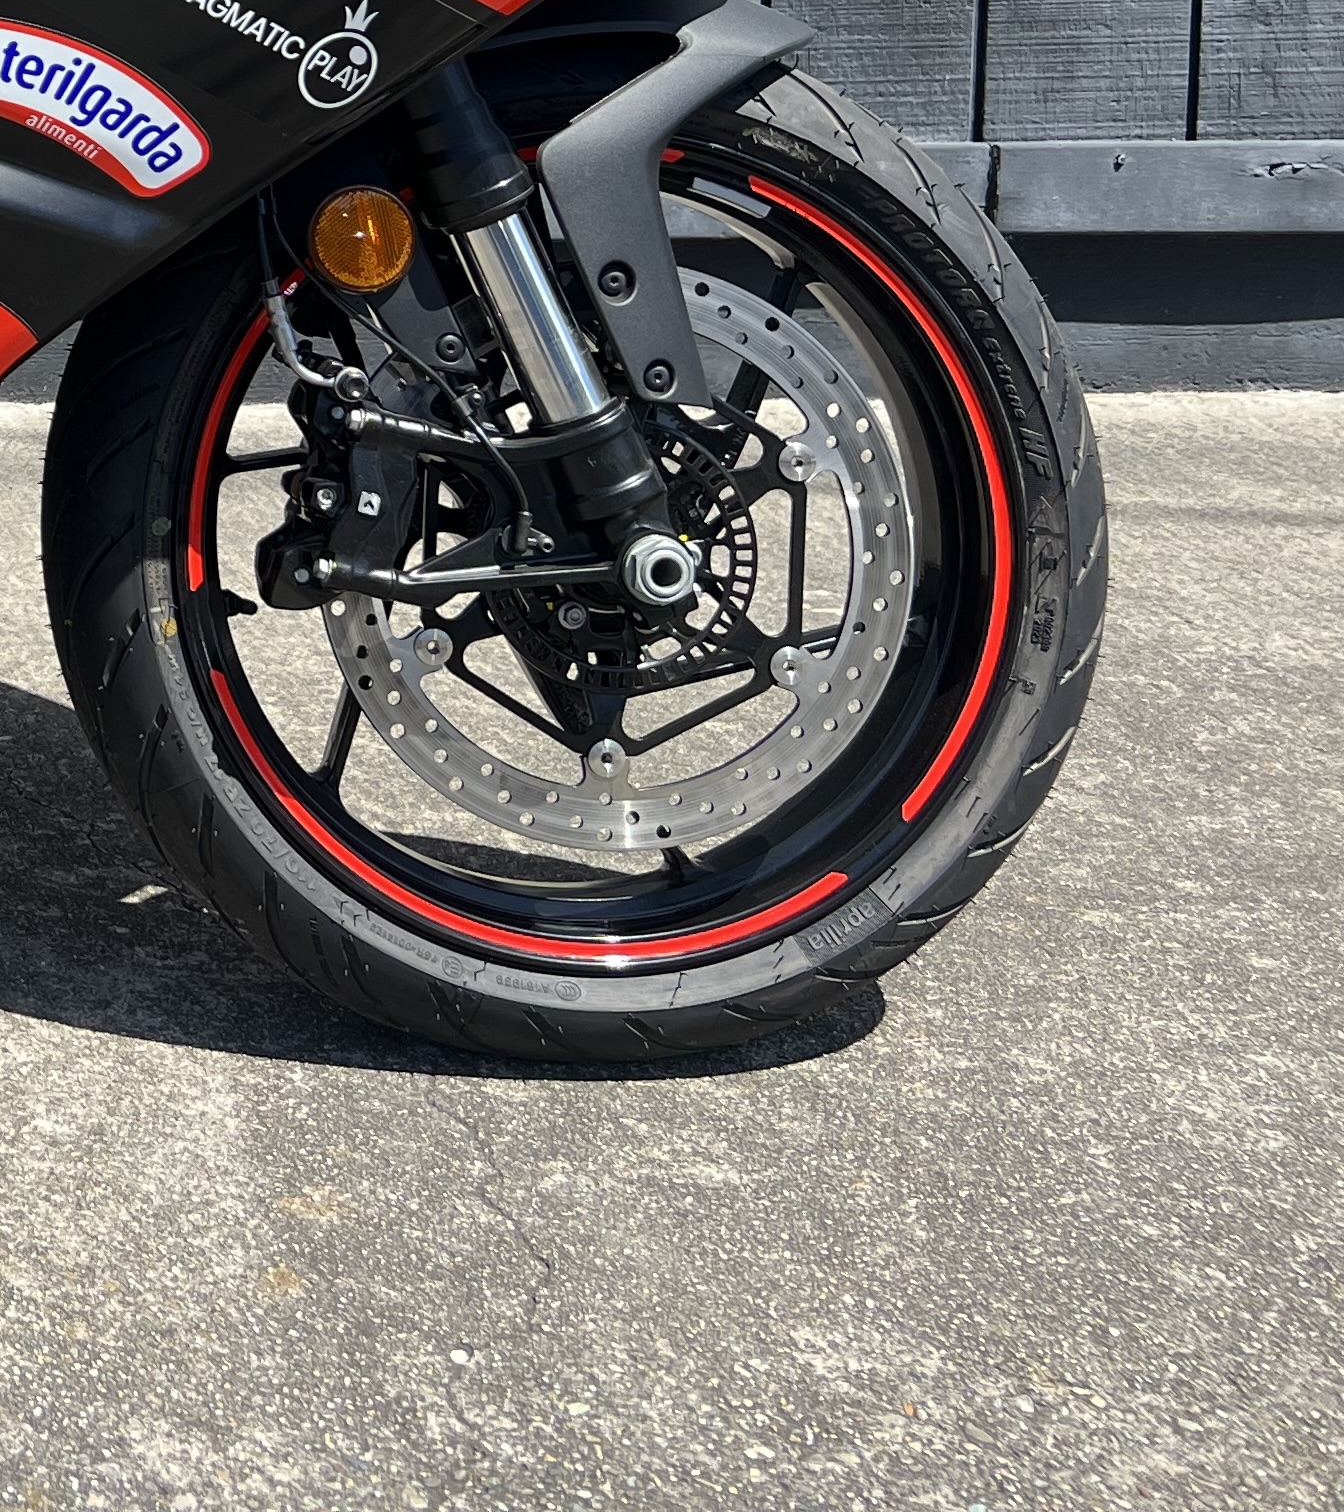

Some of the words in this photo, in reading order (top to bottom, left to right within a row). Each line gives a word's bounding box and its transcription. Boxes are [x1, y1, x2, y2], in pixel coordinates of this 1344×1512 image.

[307, 51, 369, 93] PLAY
[25, 112, 102, 160] alimenti
[805, 897, 880, 958] aprilia
